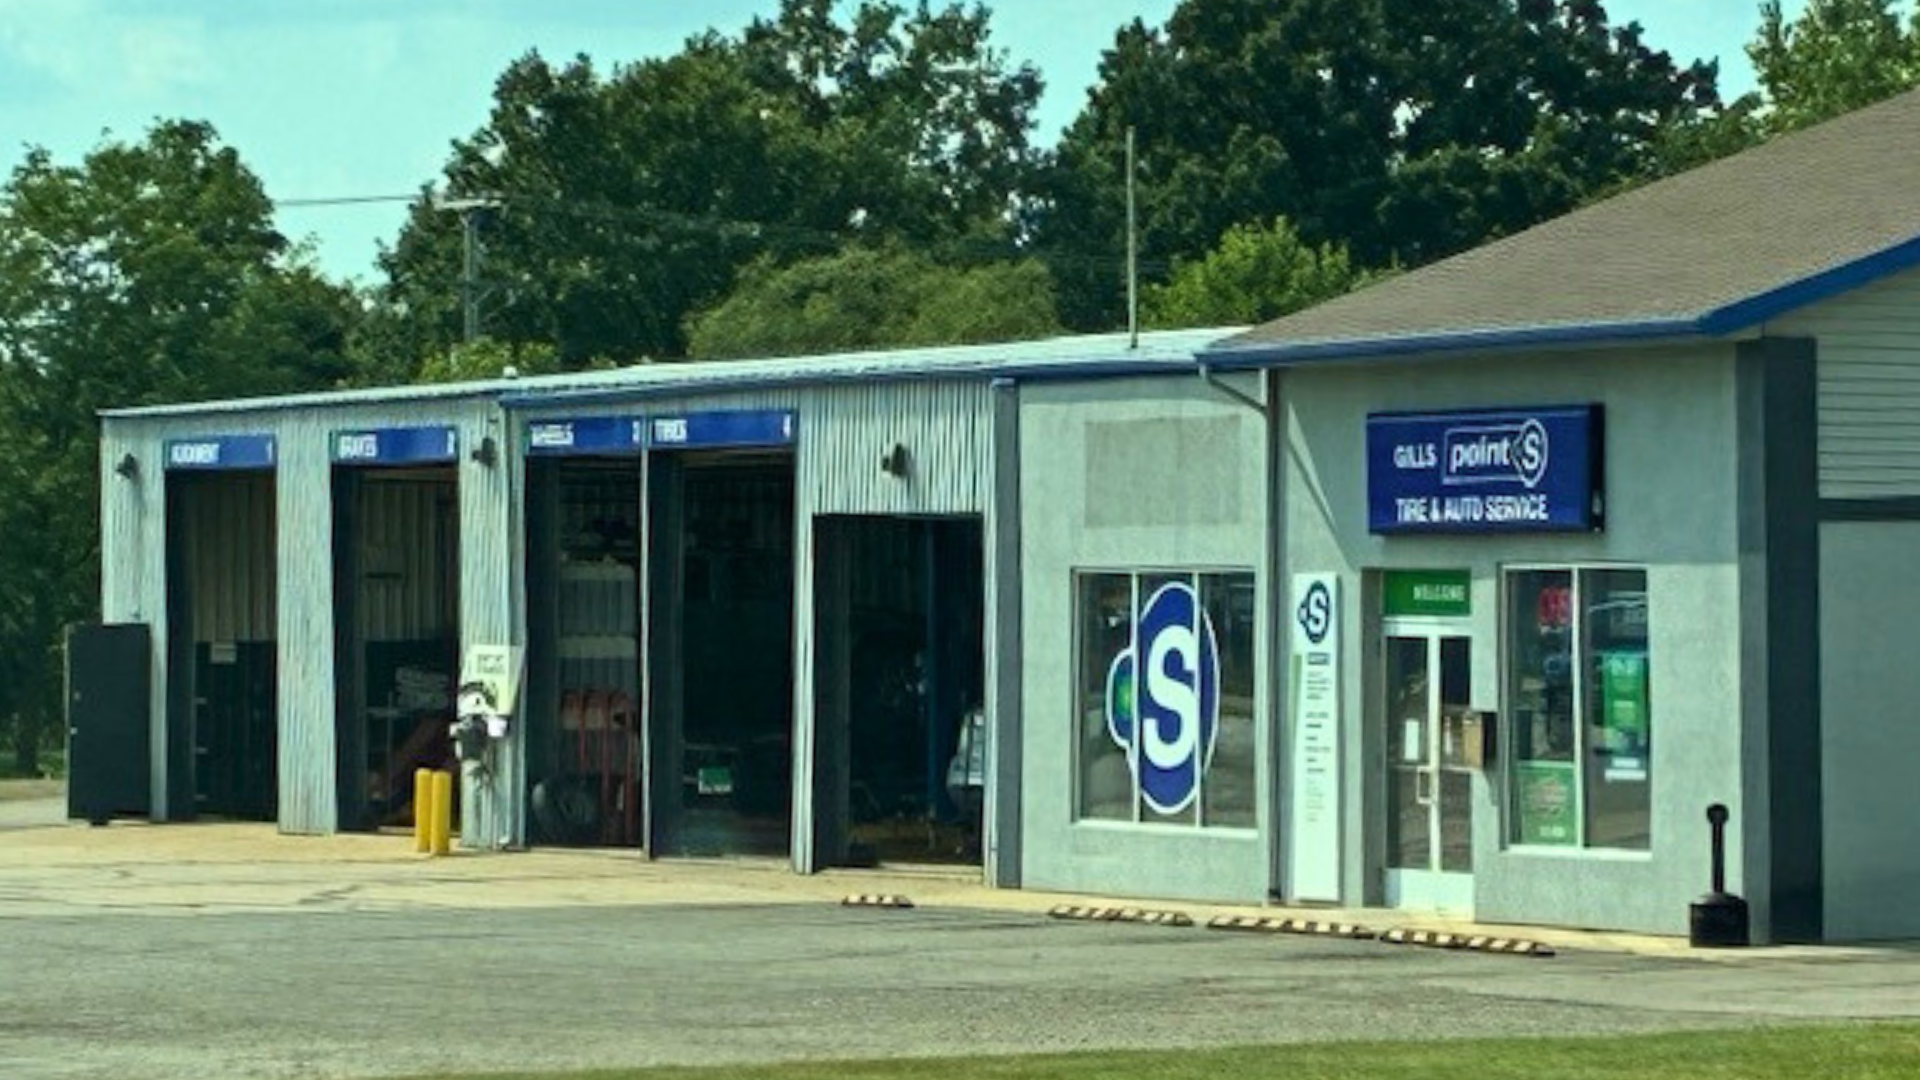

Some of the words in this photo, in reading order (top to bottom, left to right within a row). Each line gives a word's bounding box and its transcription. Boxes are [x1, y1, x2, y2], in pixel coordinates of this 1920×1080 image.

[1393, 443, 1437, 468] GILLS
[1451, 434, 1510, 473] point
[1522, 433, 1541, 470] S
[1395, 497, 1428, 522] TIRE
[1430, 497, 1441, 521] &
[1442, 496, 1483, 521] AUTO
[1485, 494, 1548, 520] SERVICE
[1307, 588, 1328, 635] S
[1143, 624, 1198, 770] S
